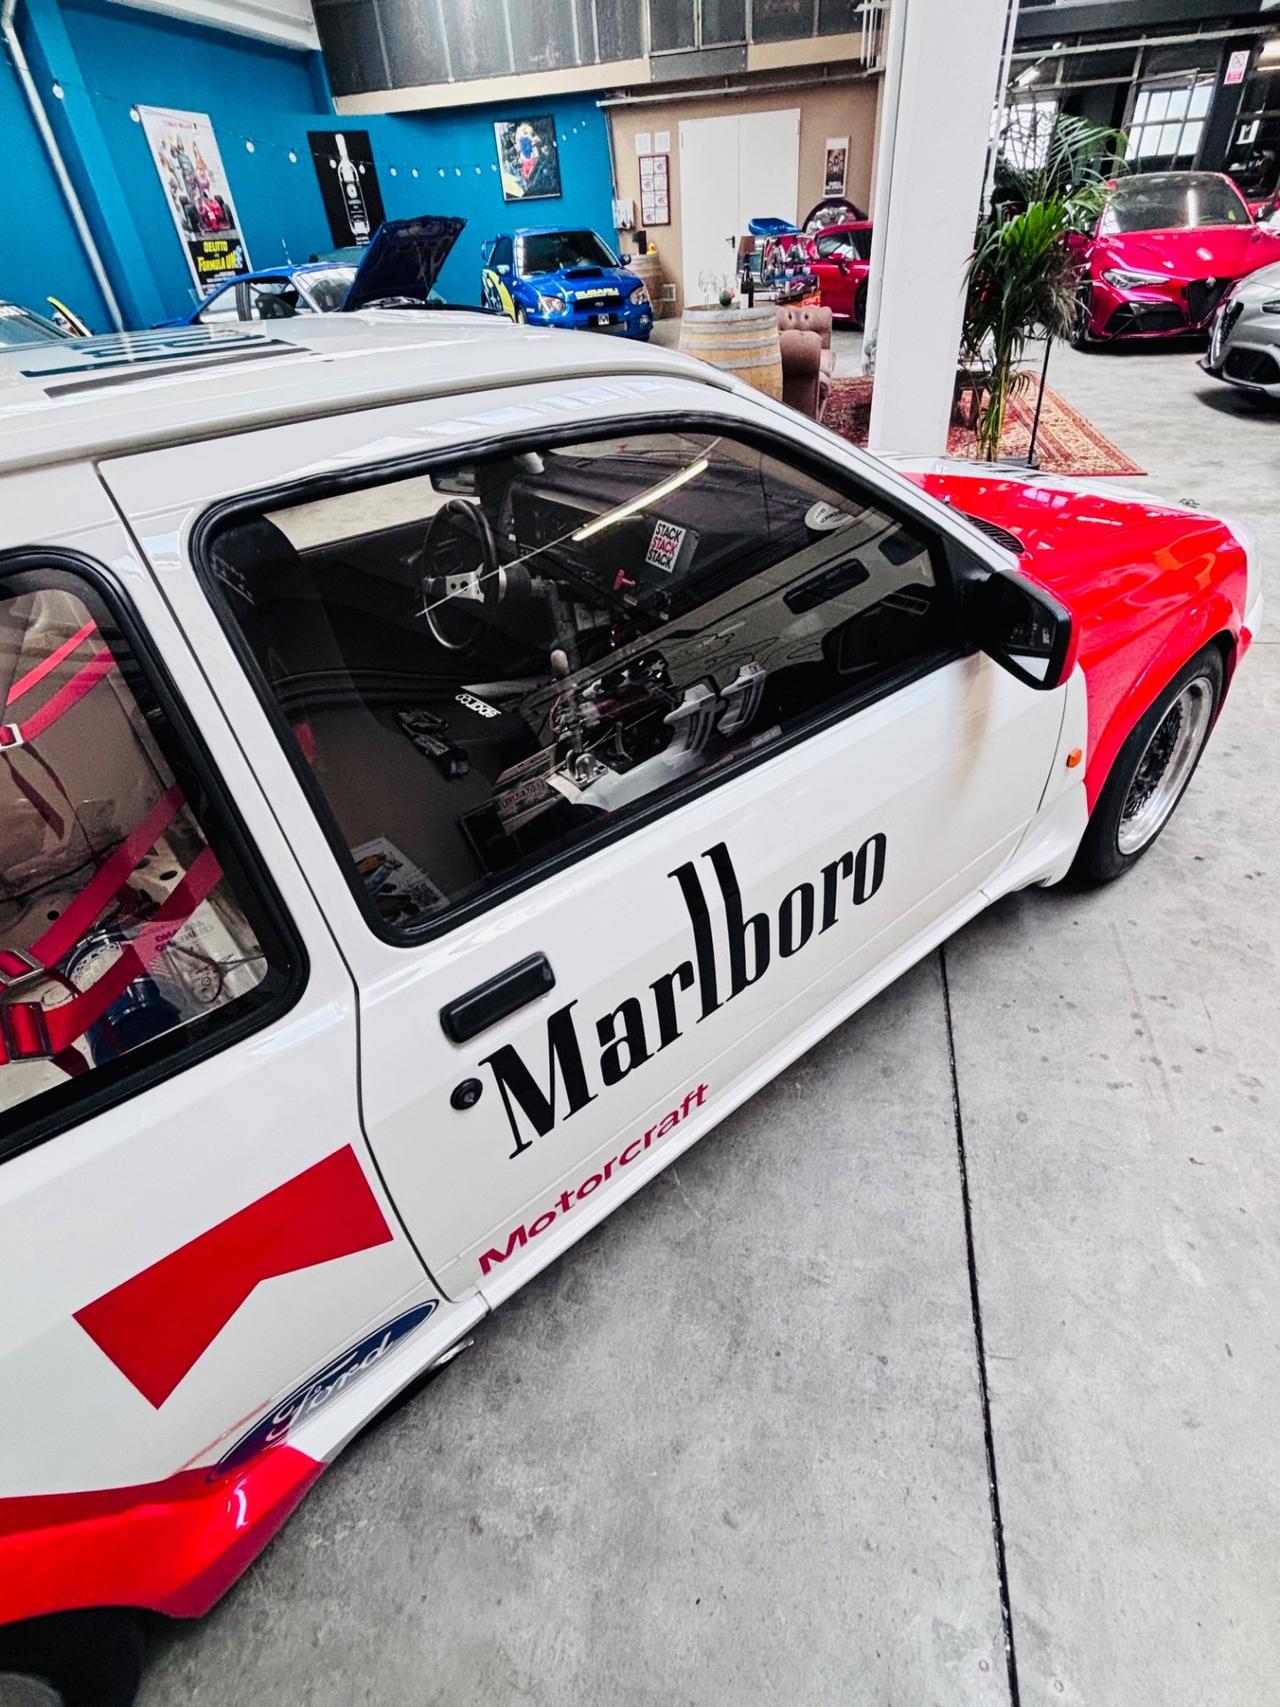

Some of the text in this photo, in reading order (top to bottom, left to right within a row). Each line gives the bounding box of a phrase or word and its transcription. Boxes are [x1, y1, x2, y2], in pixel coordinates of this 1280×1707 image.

[575, 288, 619, 300] SUBARU
[655, 523, 683, 542] STACK
[652, 536, 678, 556] STACK
[648, 548, 673, 569] STACK
[478, 832, 887, 1159] Marlboro
[478, 1083, 708, 1276] Motorcraft
[265, 1331, 396, 1442] Ford
